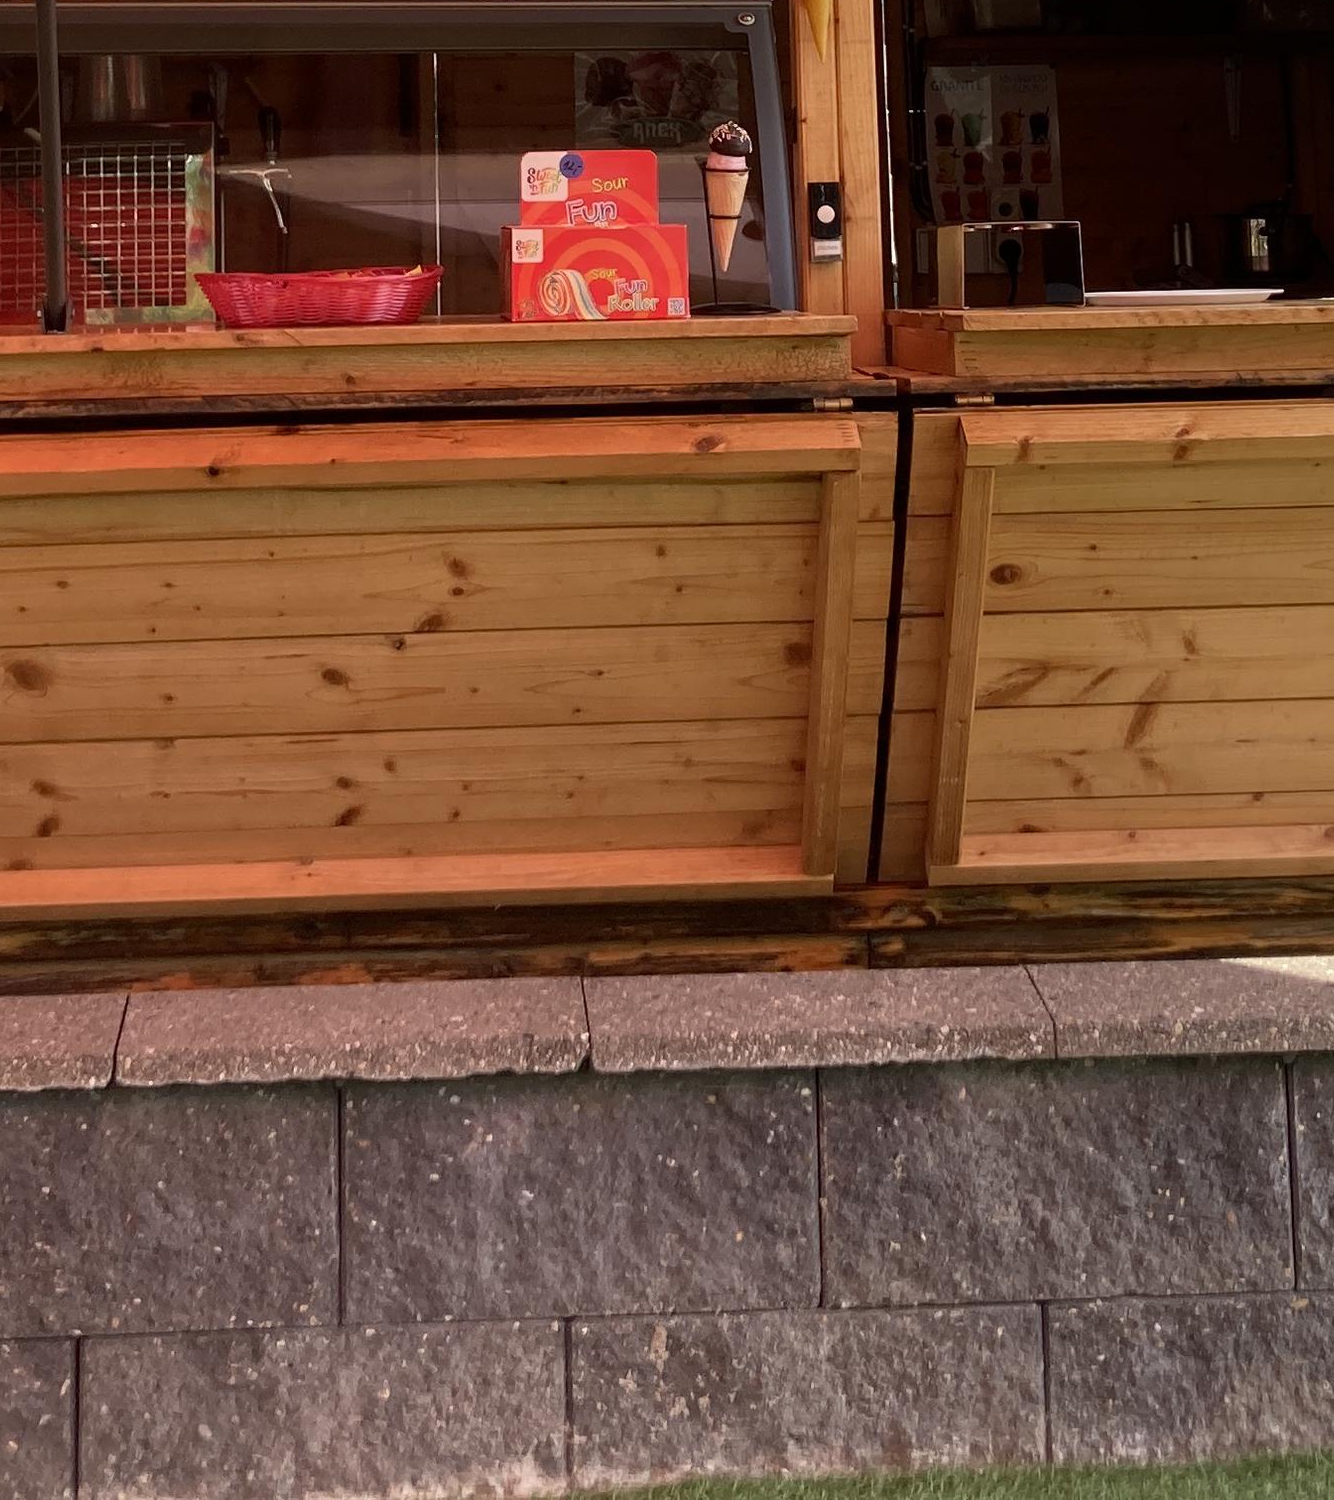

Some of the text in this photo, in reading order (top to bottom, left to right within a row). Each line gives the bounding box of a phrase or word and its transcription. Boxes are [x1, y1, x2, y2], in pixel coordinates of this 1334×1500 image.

[591, 177, 629, 193] Sour
[565, 198, 617, 225] Fun
[592, 268, 618, 278] Sour
[614, 277, 648, 295] Fun
[607, 293, 660, 312] Roller
